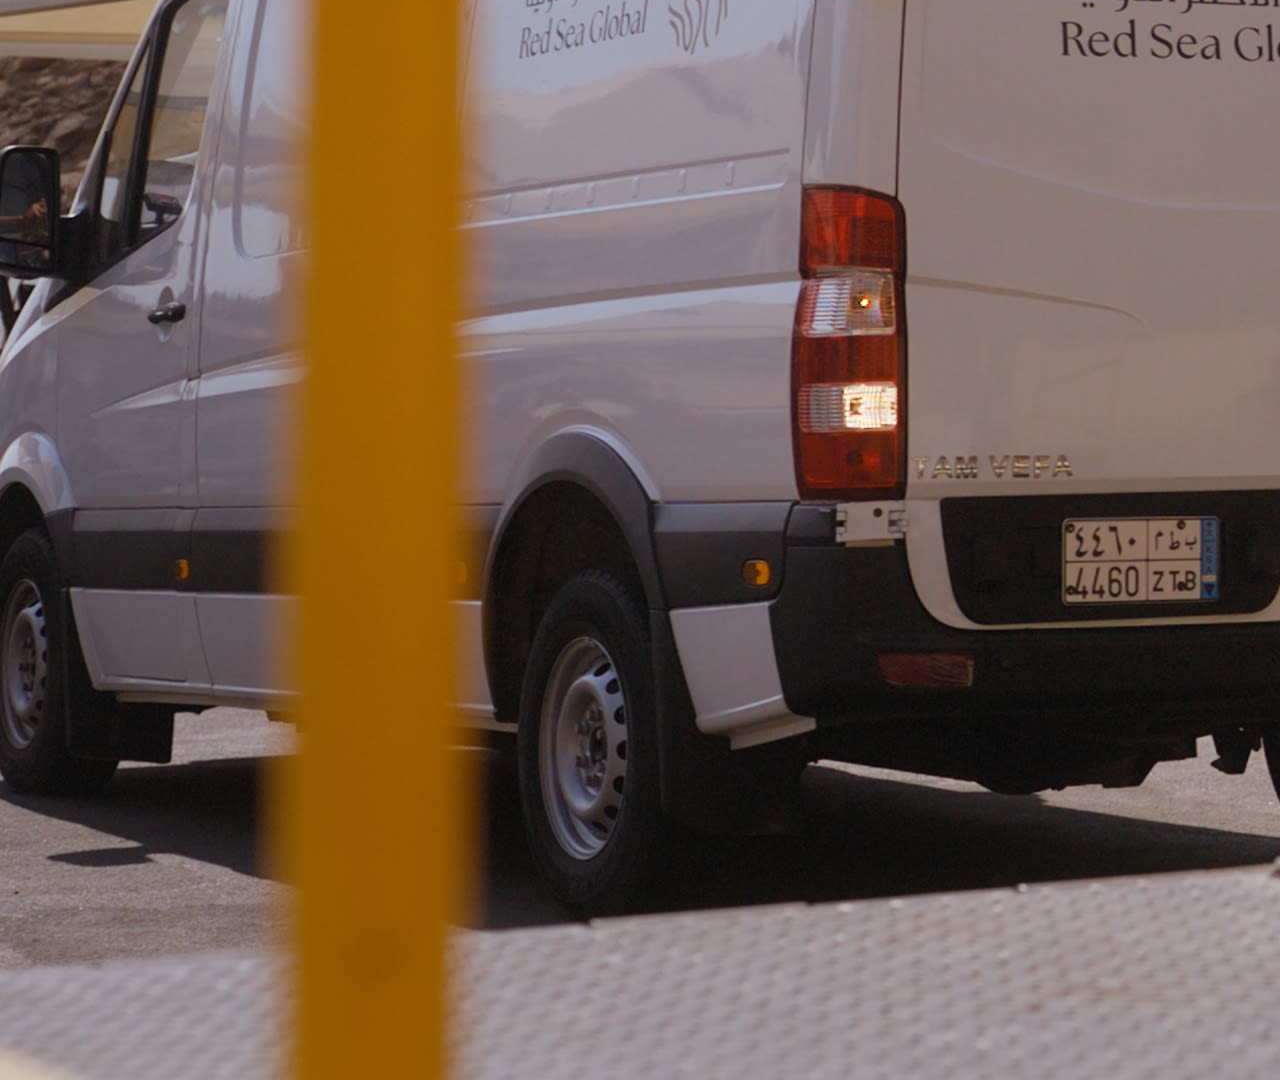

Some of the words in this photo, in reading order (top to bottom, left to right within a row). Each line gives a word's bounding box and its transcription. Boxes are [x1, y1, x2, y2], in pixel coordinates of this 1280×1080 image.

[518, 17, 553, 59] Red
[554, 18, 585, 51] Sea
[1061, 19, 1137, 57] Red
[1150, 23, 1221, 60] Sea
[912, 455, 979, 479] TAM
[1074, 566, 1140, 599] 4460
